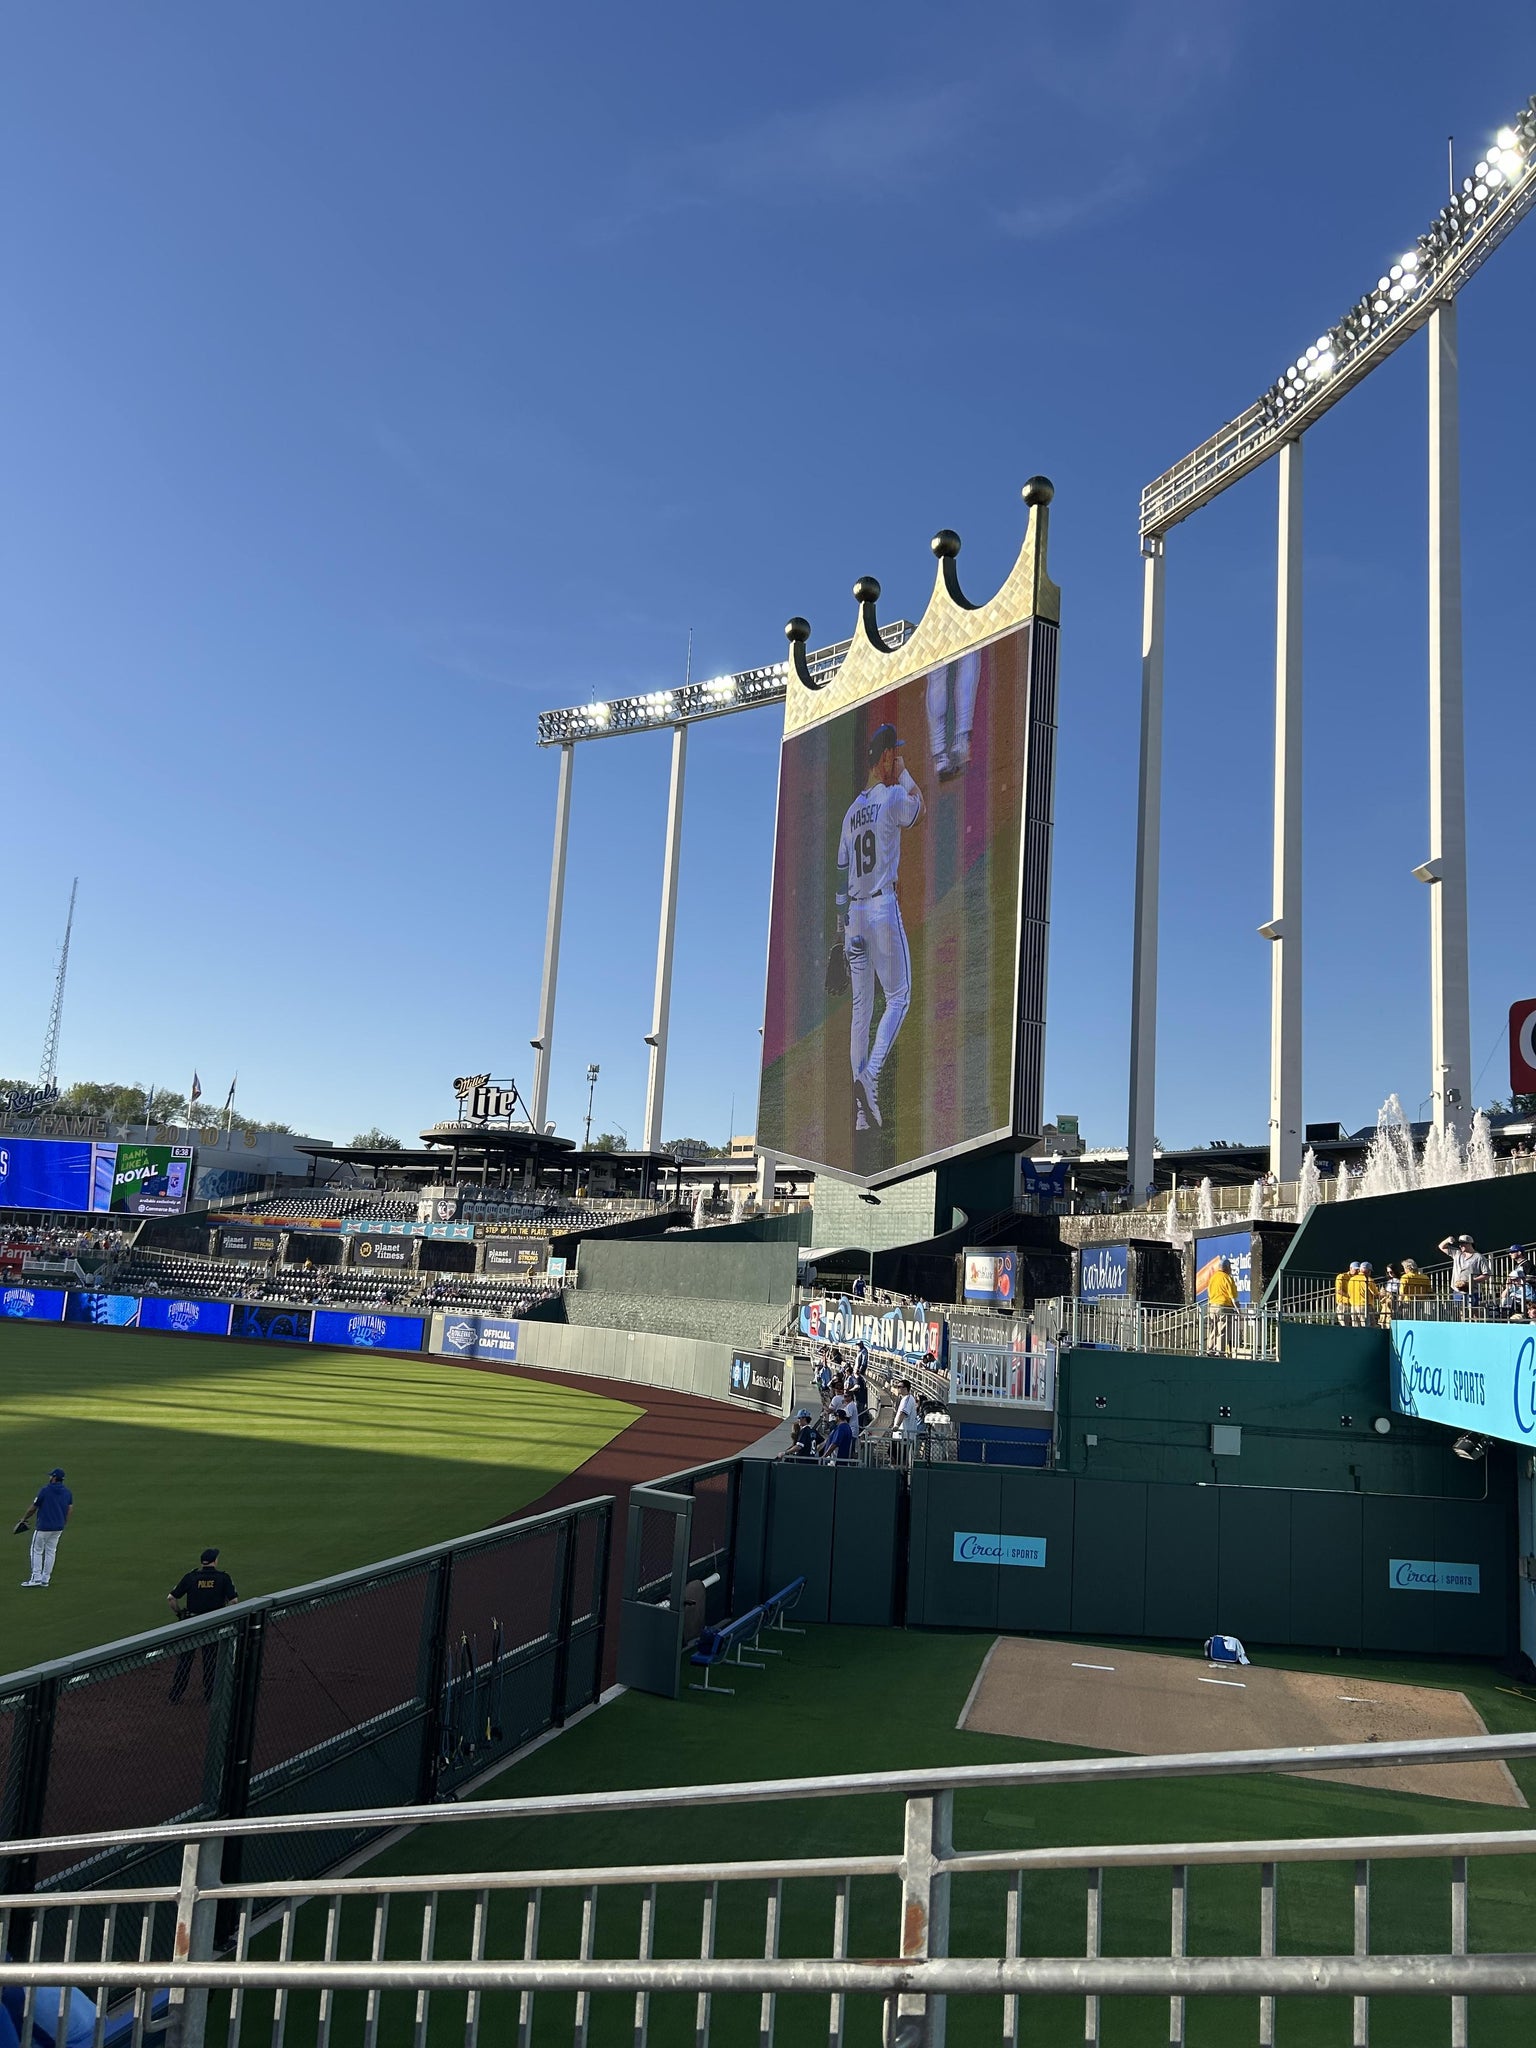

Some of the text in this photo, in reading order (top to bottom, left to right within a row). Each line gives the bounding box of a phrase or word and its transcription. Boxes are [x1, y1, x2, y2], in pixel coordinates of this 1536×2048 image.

[850, 803, 882, 832] MASSEY
[854, 829, 876, 878] 19
[456, 1074, 489, 1096] Miller
[5, 1084, 58, 1113] Royals
[464, 1086, 516, 1124] Lite
[16, 1116, 40, 1136] of
[40, 1113, 107, 1137] FAME
[244, 1127, 257, 1148] 5
[121, 1159, 141, 1170] LIKE
[122, 1148, 148, 1161] BANK
[115, 1164, 158, 1185] ROYAL
[223, 1236, 244, 1244] planet
[374, 1243, 401, 1253] planet
[0, 1245, 32, 1259] Farm
[377, 1250, 405, 1260] fitness
[488, 1249, 509, 1258] planet
[490, 1256, 512, 1264] fitness
[1083, 1252, 1126, 1291] carbliss
[3, 1289, 35, 1306] FOUNTAINS
[168, 1302, 200, 1320] FOUNTAINS
[348, 1315, 387, 1335] FOUNTAINS
[483, 1328, 511, 1340] OFFICIAL
[825, 1311, 894, 1349] FOUNTAIN
[897, 1319, 928, 1352] DECK
[479, 1338, 499, 1348] CRAFT
[499, 1341, 515, 1351] BEER
[1399, 1329, 1446, 1406] Circa
[1453, 1369, 1486, 1406] SPORTS
[751, 1369, 783, 1397] Kansas City
[960, 1535, 1039, 1560] Circa SPORTS
[197, 1580, 215, 1588] POLICE
[1396, 1562, 1473, 1586] Circa SPORTS
